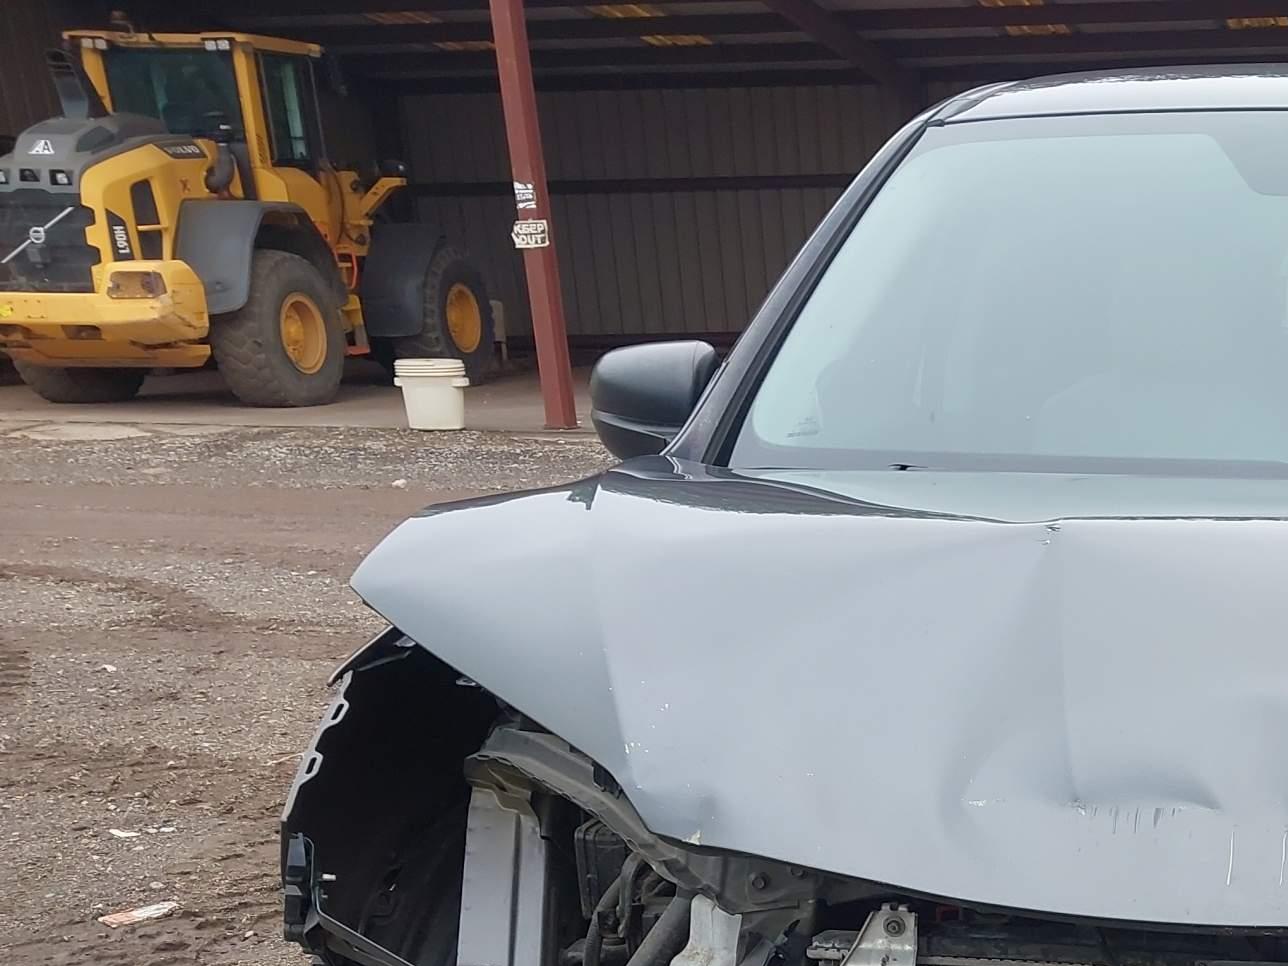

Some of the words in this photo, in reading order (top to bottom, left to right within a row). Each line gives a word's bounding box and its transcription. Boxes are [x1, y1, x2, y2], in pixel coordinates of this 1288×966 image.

[514, 223, 545, 234] KEEP
[112, 225, 131, 254] L90H
[518, 234, 545, 245] OUT
